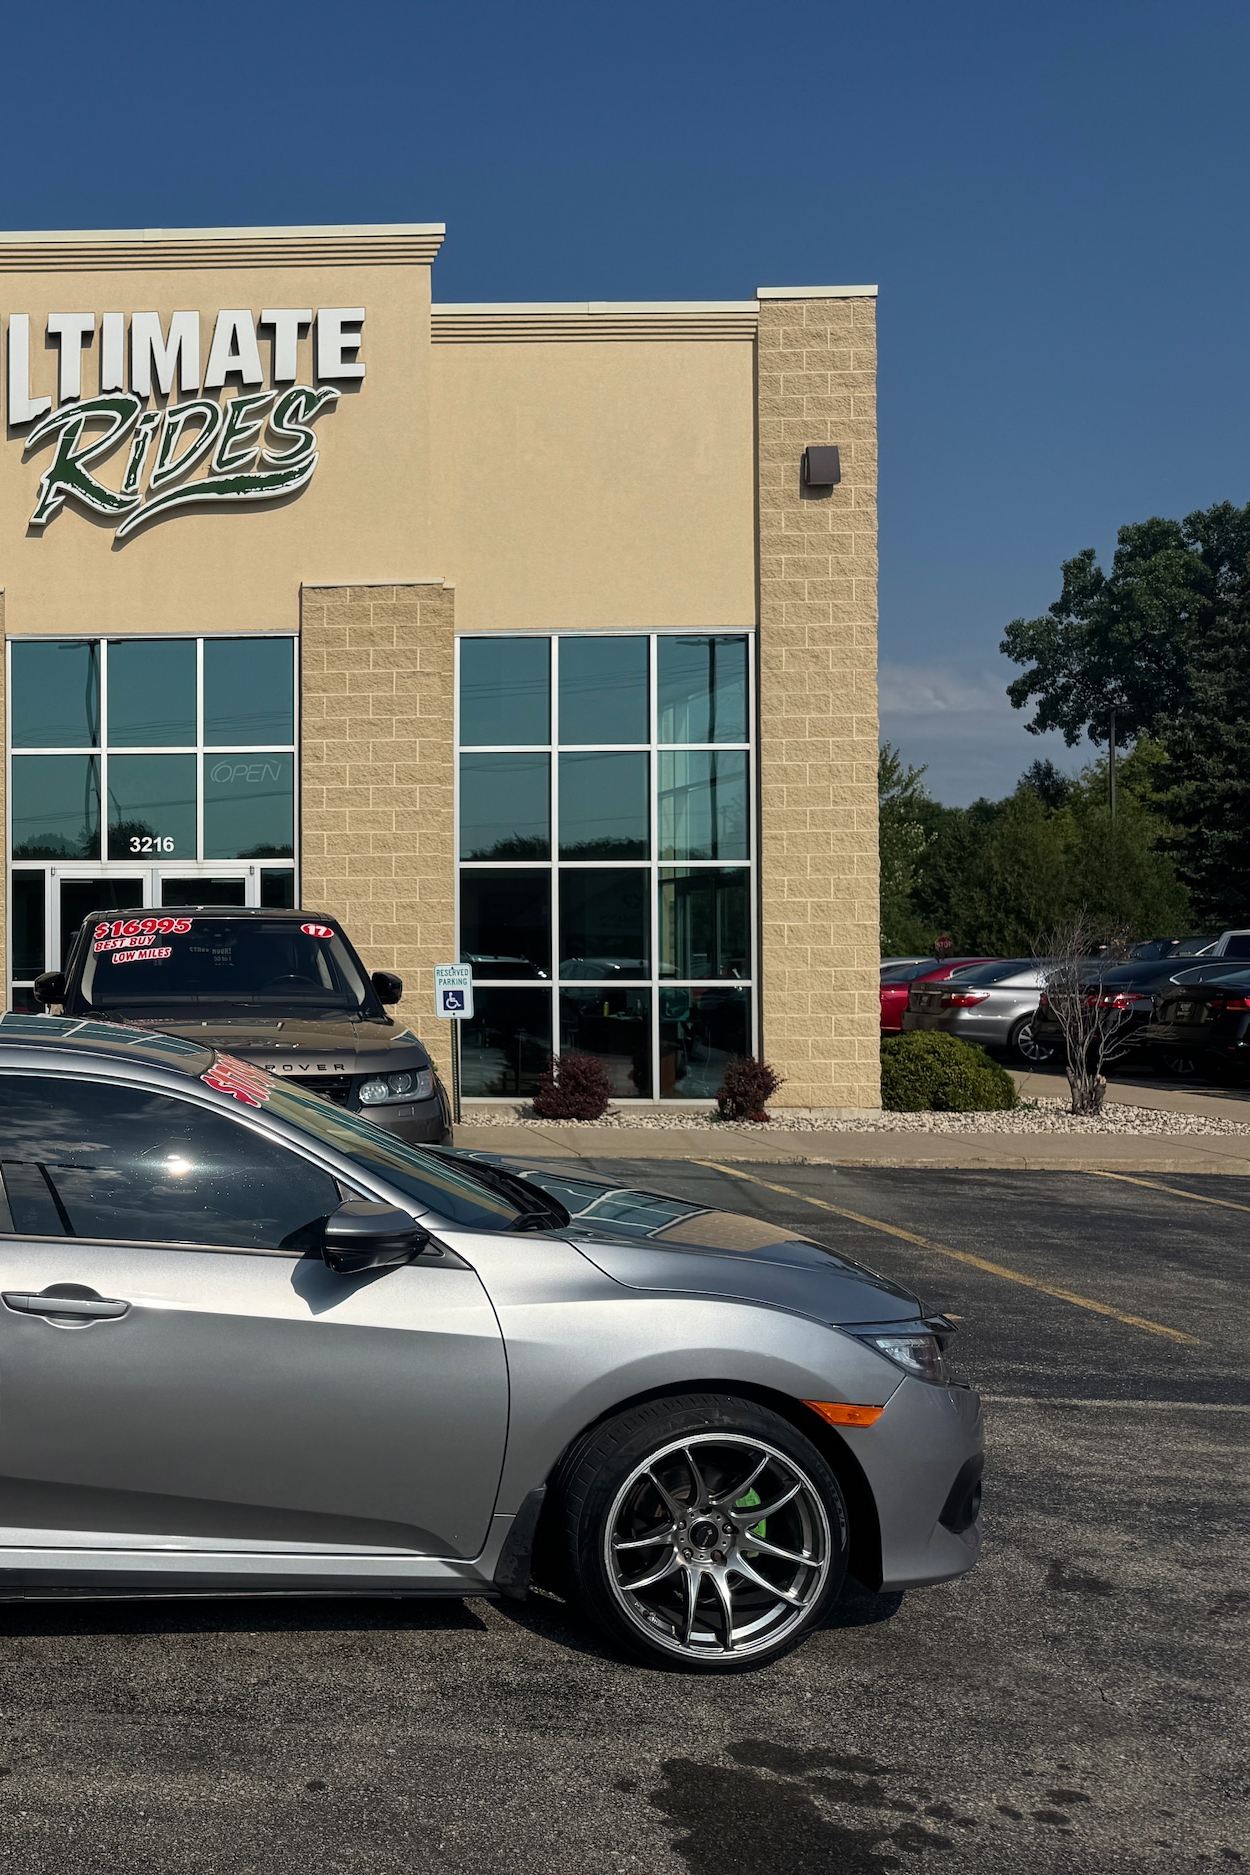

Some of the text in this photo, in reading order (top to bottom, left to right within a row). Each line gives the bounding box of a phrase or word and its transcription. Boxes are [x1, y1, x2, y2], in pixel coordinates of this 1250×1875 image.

[213, 763, 282, 783] OPEN
[129, 836, 175, 853] 3216
[94, 917, 193, 939] $16995
[307, 925, 328, 937] 17
[94, 935, 156, 952] BEST BUY
[112, 947, 172, 964] LOW MILES
[436, 968, 469, 977] RESERVED
[438, 978, 468, 986] PARKING
